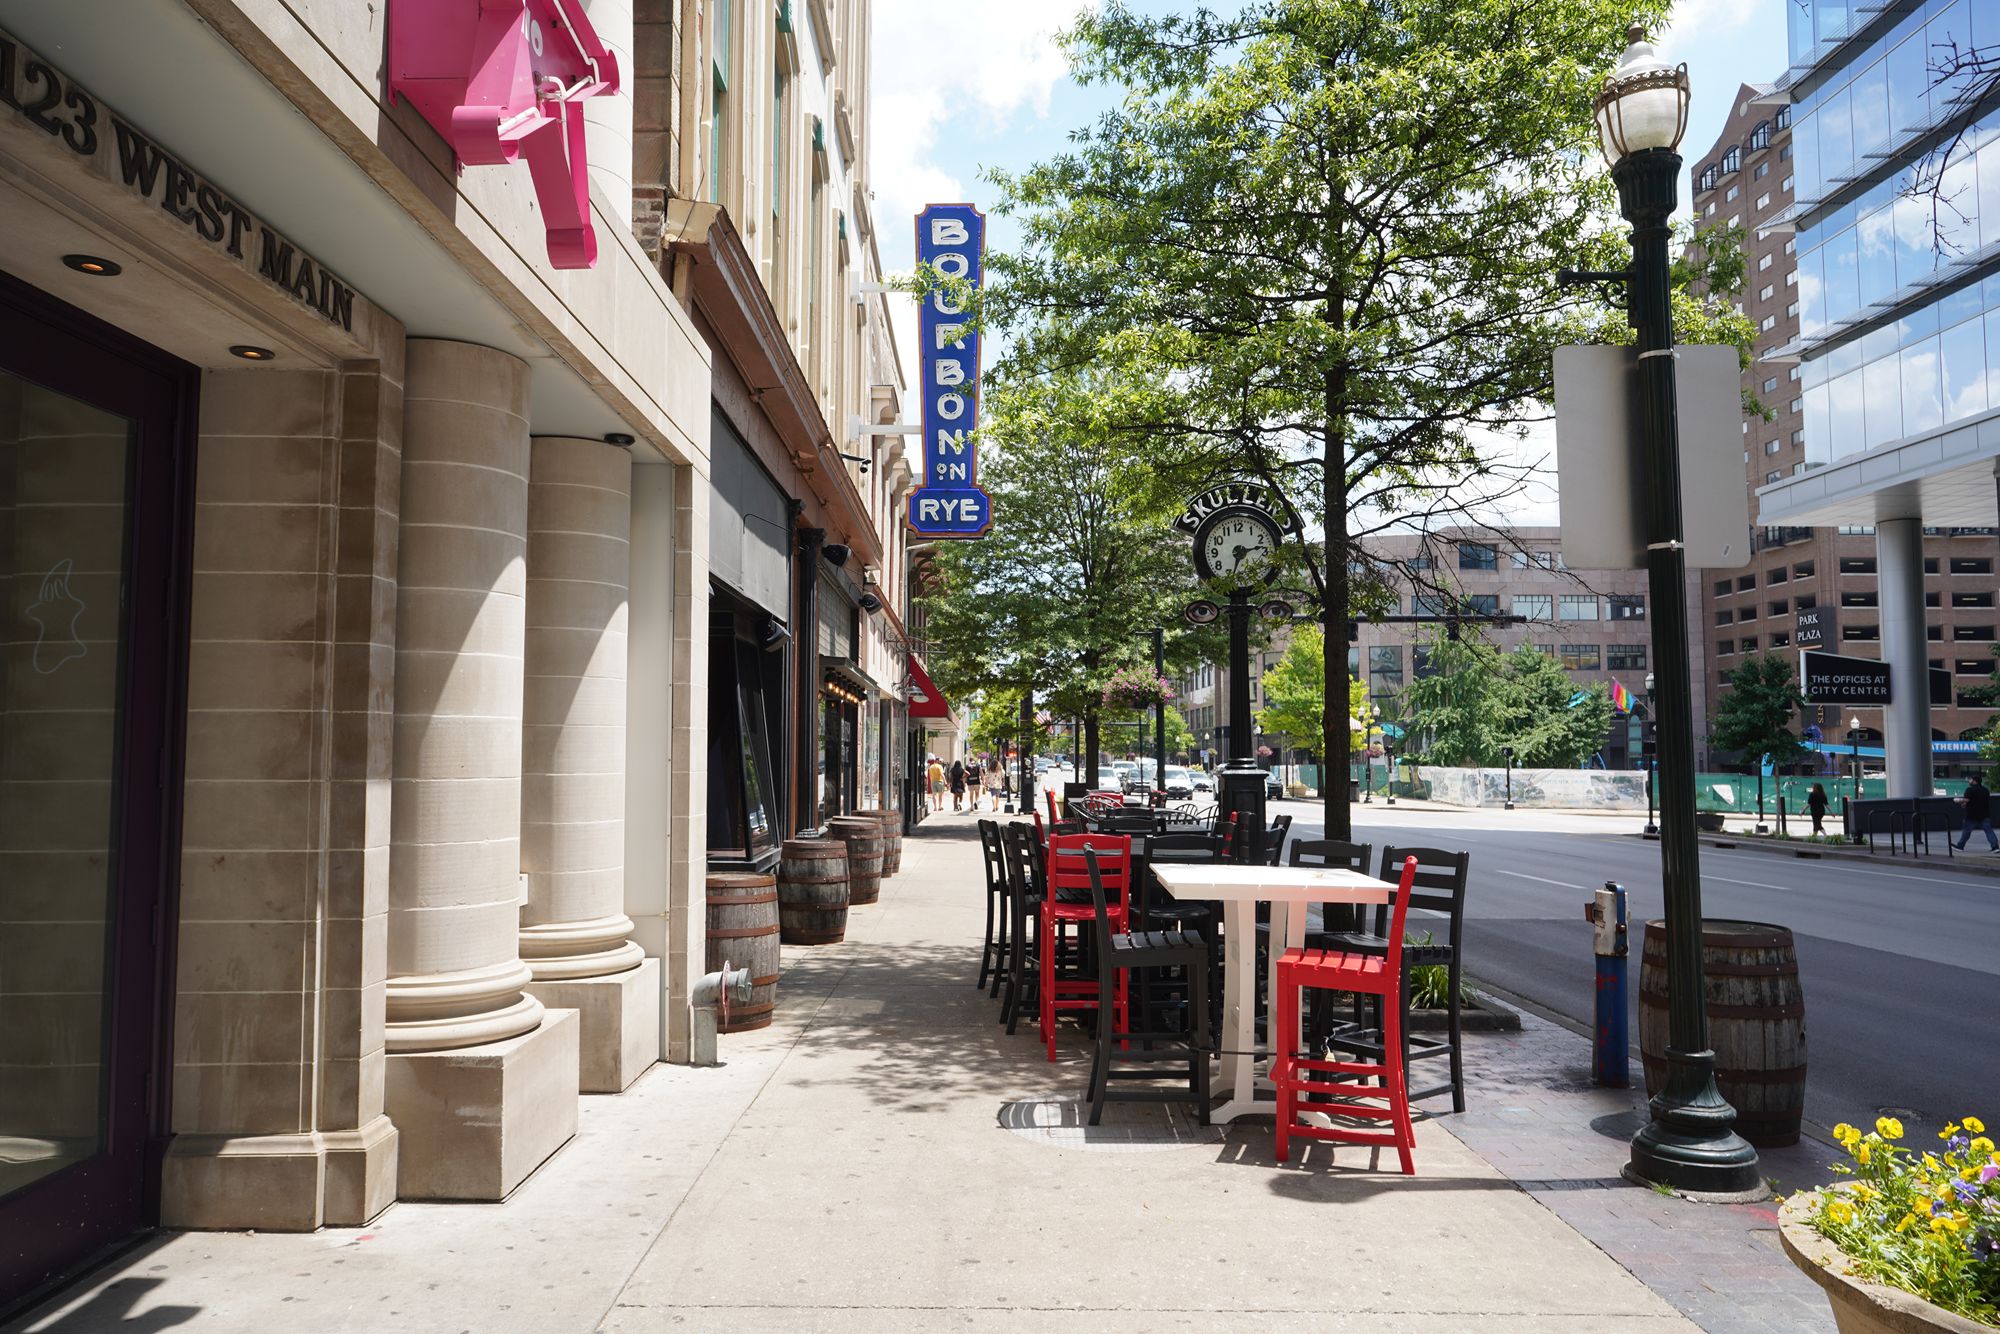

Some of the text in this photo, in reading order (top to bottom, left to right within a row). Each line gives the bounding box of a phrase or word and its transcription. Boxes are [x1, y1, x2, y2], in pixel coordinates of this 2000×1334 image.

[0, 36, 355, 333] 123 WEST MAIN
[932, 218, 969, 455] BOURBON
[919, 498, 980, 522] RYE
[1222, 526, 1230, 536] 11
[1233, 522, 1244, 533] 12
[1213, 535, 1224, 546] 10
[1257, 534, 1264, 544] 2
[1211, 547, 1219, 558] 9
[1215, 560, 1222, 570] 8
[1799, 613, 1819, 626] PARK
[1797, 629, 1822, 641] PLAZA
[1811, 675, 1886, 684] THE OFFICES AT
[1811, 686, 1887, 695] CITY CENTER
